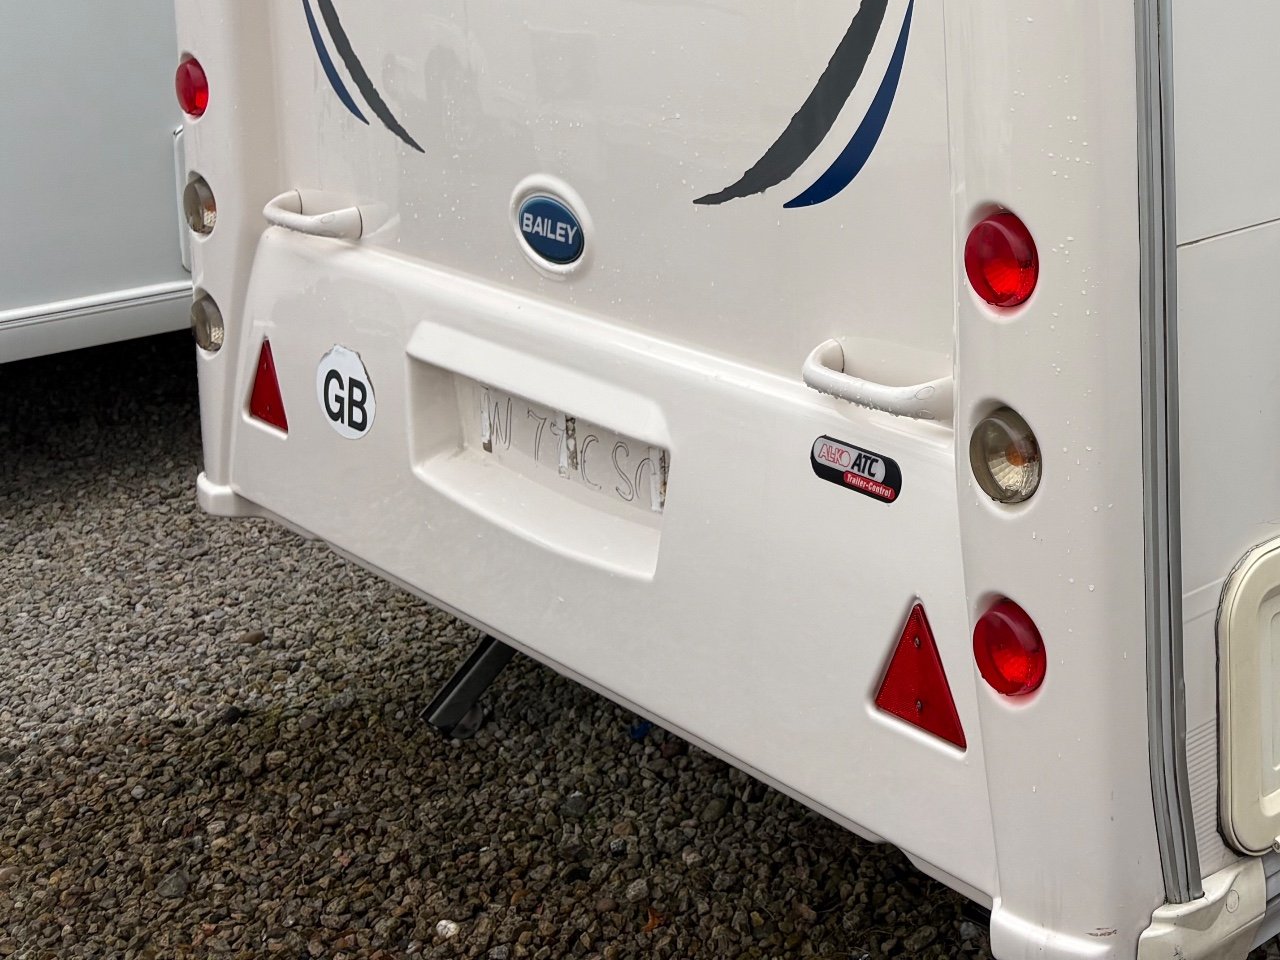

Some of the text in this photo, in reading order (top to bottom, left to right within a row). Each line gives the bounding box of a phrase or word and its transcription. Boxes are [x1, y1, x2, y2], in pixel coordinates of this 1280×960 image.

[522, 211, 578, 245] BAILEY
[323, 368, 368, 432] GB
[850, 452, 879, 478] ATC
[846, 473, 892, 498] Trailer-Control
